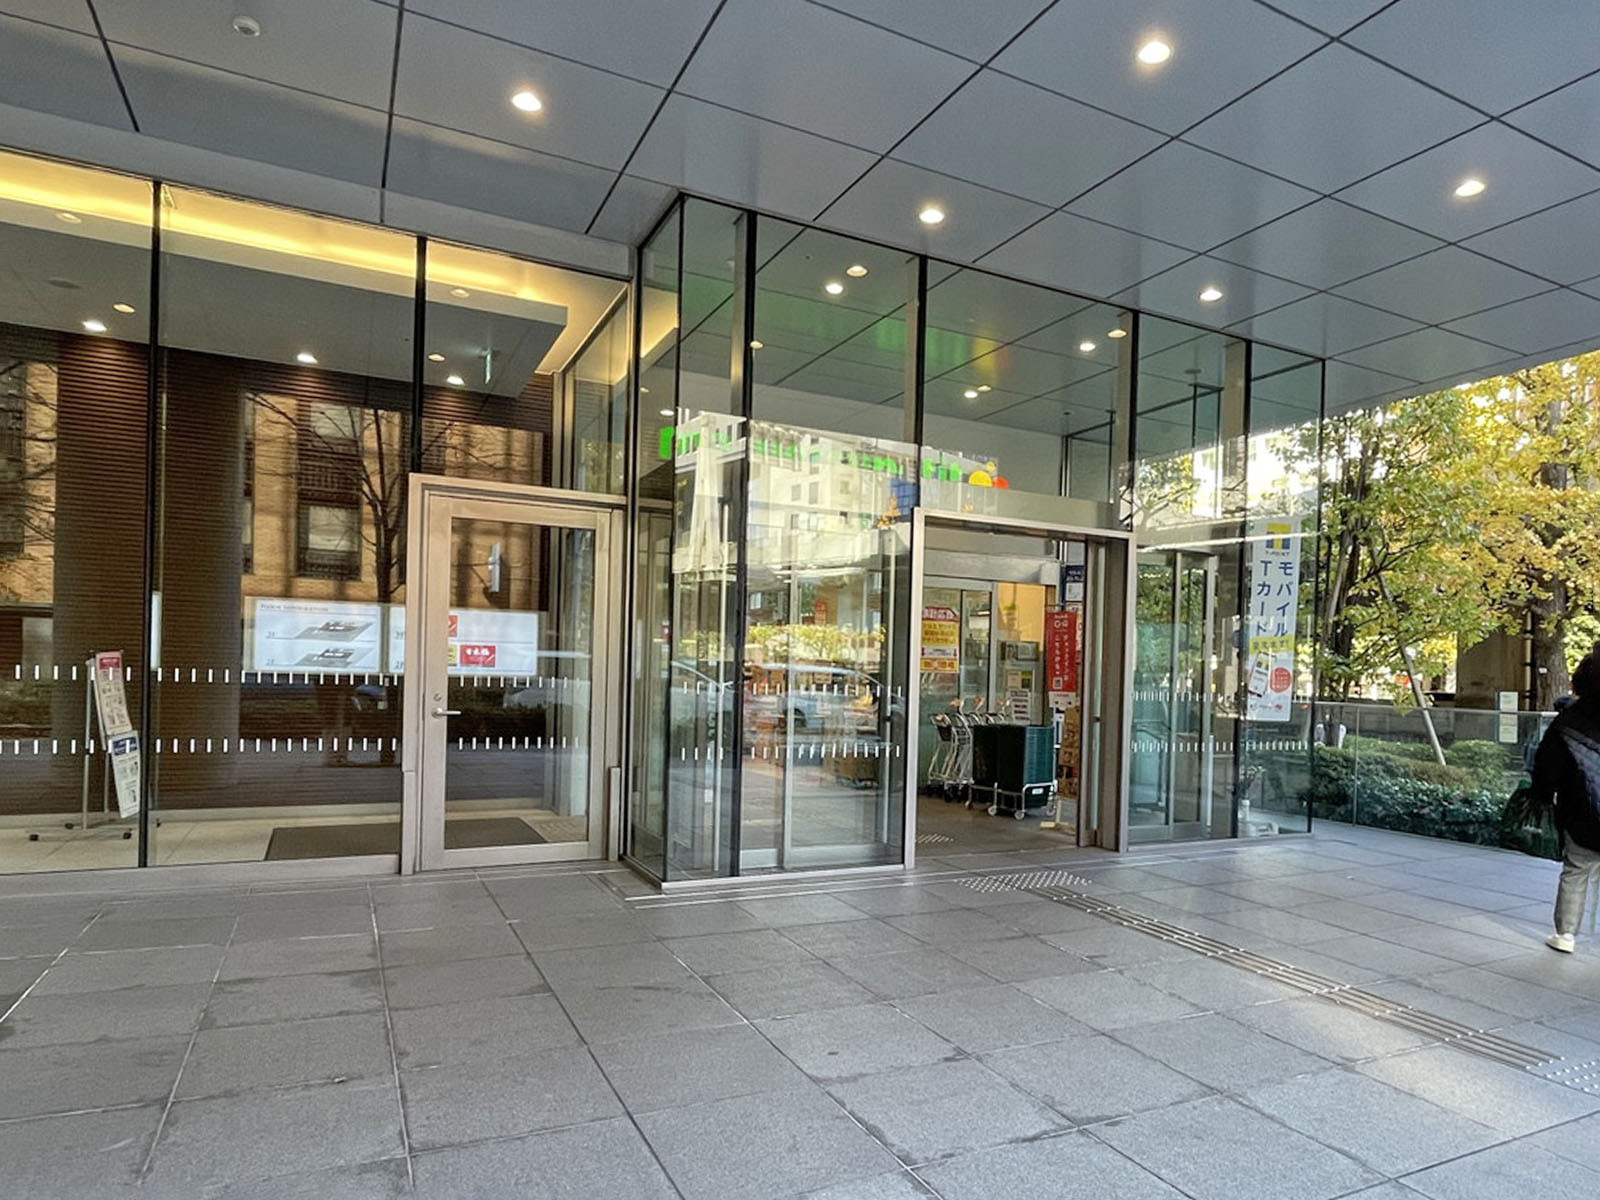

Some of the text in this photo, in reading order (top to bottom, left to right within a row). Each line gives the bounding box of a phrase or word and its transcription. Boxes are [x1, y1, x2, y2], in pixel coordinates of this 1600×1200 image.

[1255, 560, 1273, 637] Tカード
[1274, 561, 1294, 637] モバイル
